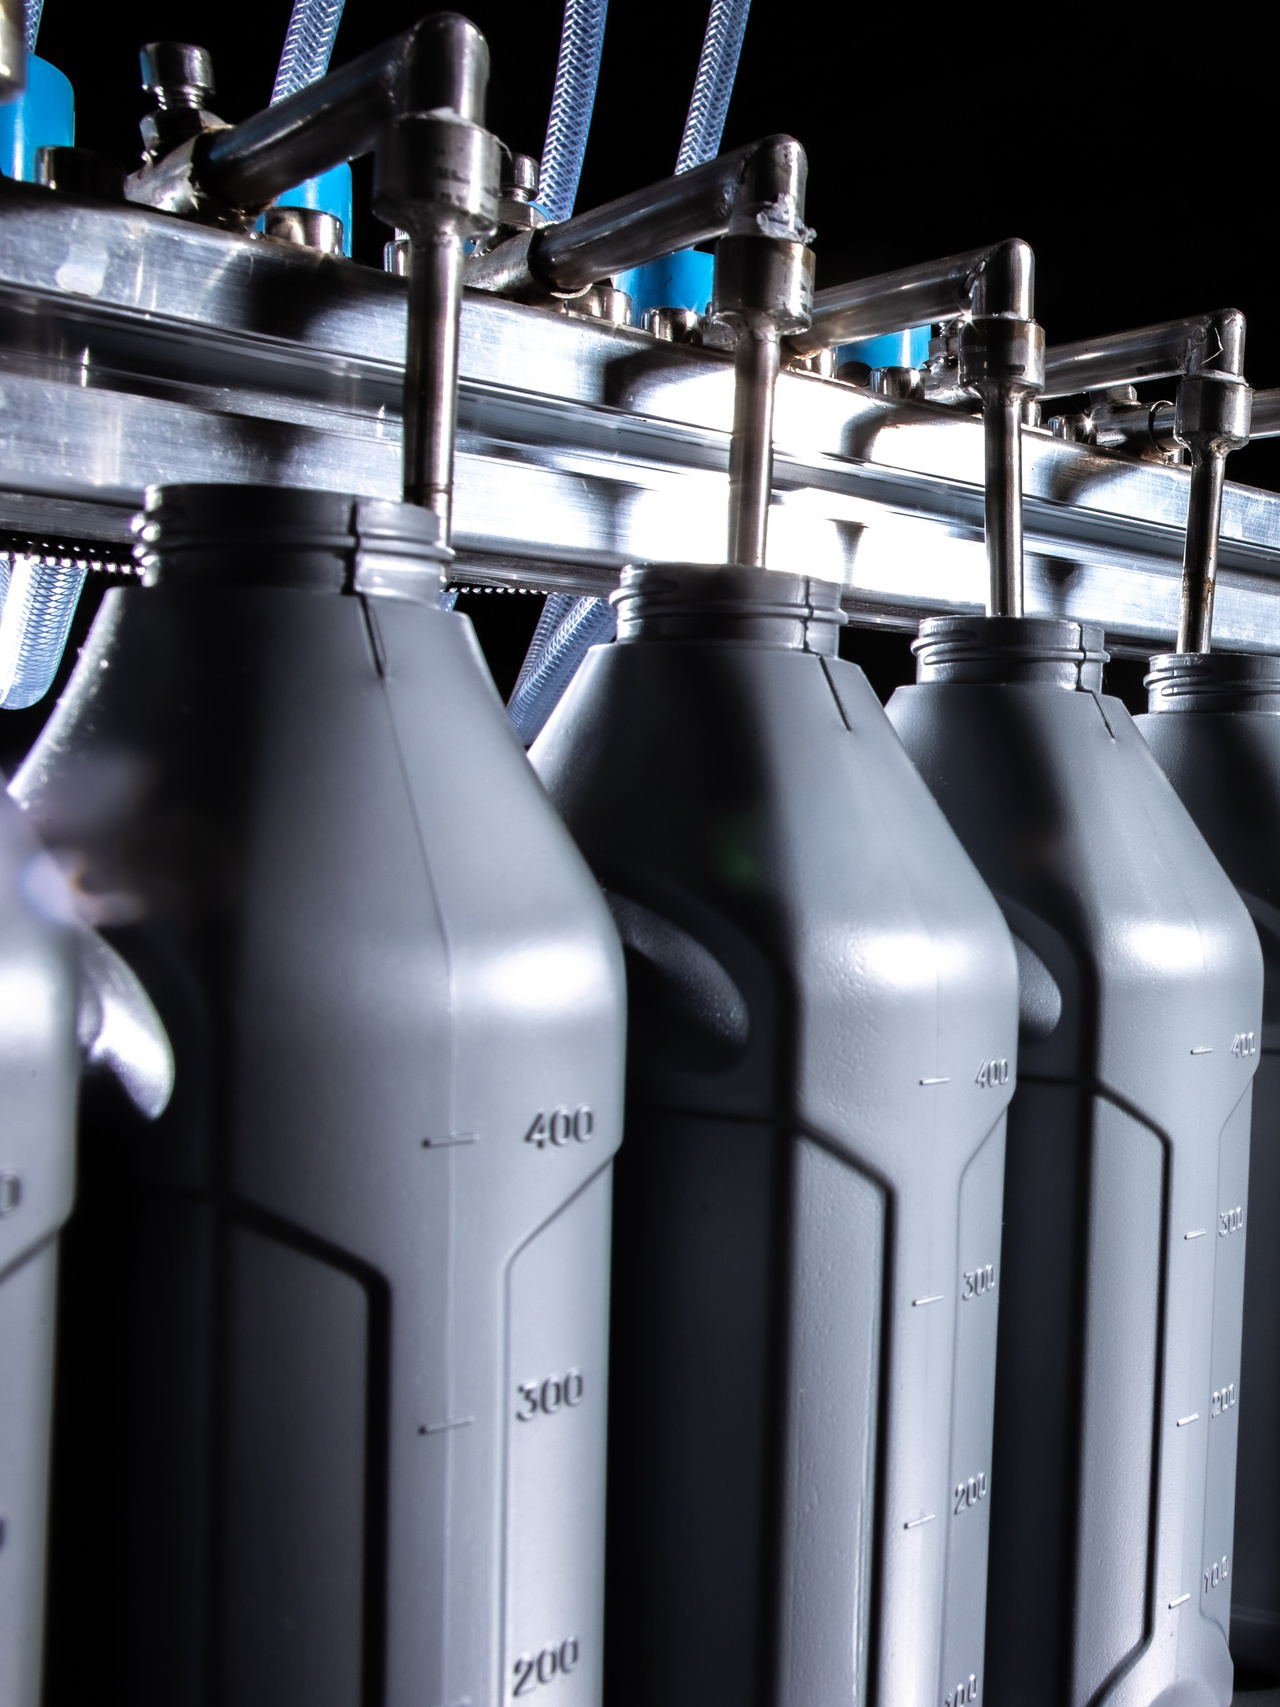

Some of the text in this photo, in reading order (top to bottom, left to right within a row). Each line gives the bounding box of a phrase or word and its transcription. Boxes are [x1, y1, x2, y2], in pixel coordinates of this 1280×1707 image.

[1231, 1032, 1256, 1058] 400
[975, 1057, 1009, 1089] 400
[523, 1104, 595, 1149] 400
[1219, 1206, 1243, 1238] 300
[962, 1264, 995, 1301] 300
[516, 1367, 585, 1422] 300
[1211, 1383, 1235, 1419] 200
[954, 1471, 986, 1516] 200
[1204, 1555, 1228, 1594] 100
[512, 1634, 580, 1698] 200
